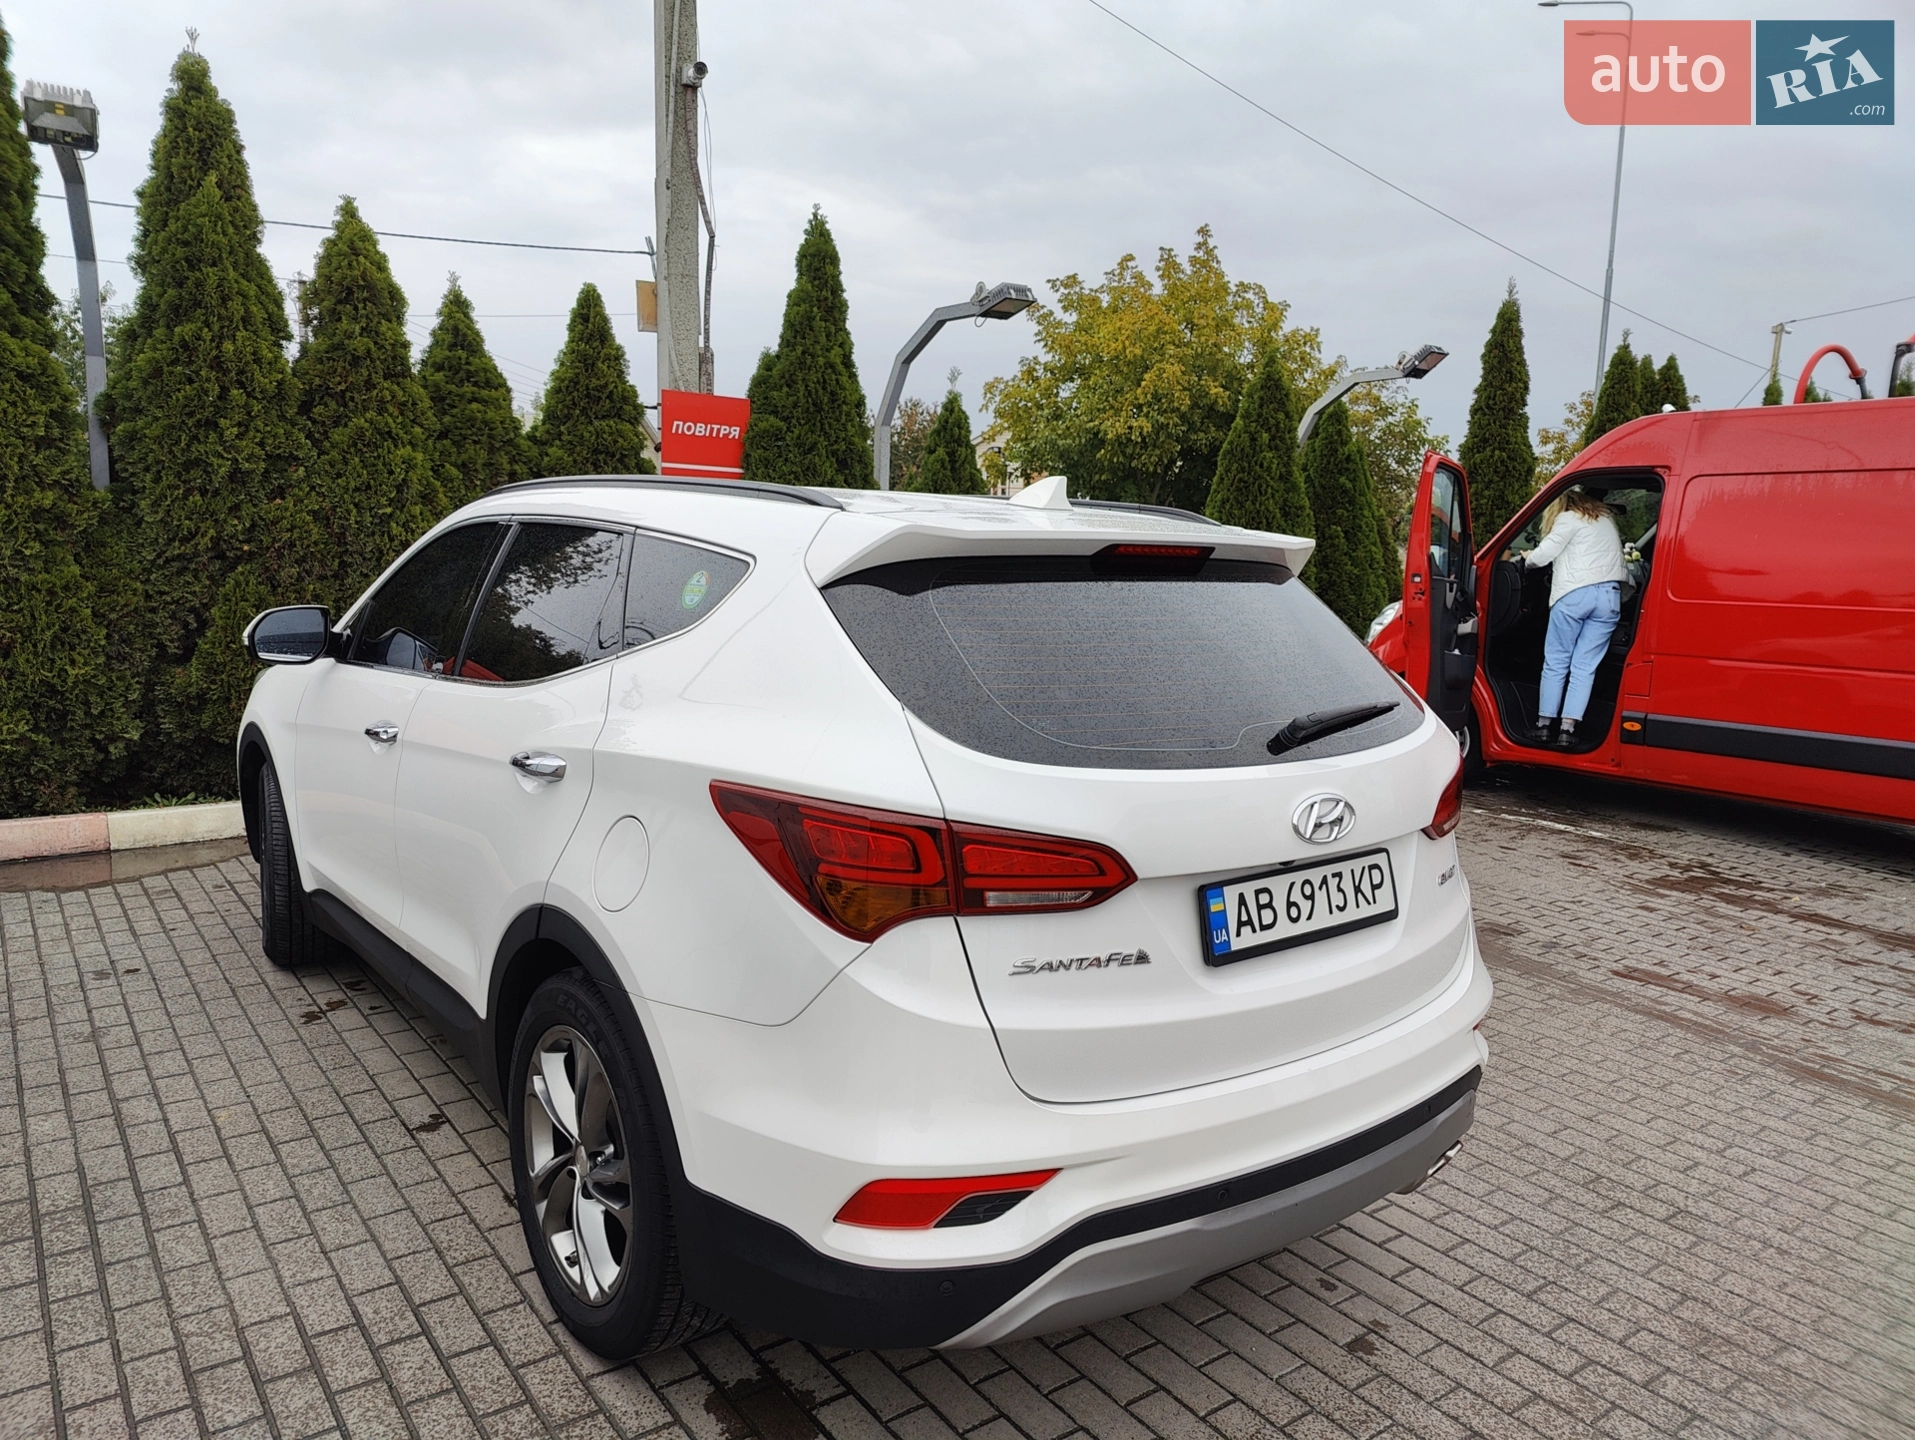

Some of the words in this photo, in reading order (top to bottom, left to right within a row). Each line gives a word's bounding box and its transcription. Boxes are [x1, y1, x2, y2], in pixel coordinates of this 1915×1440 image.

[671, 421, 740, 439] ПОВІТРЯ
[1235, 886, 1278, 938] AB
[1285, 871, 1348, 924] 6913
[1350, 863, 1385, 909] KP
[1213, 927, 1229, 944] UA
